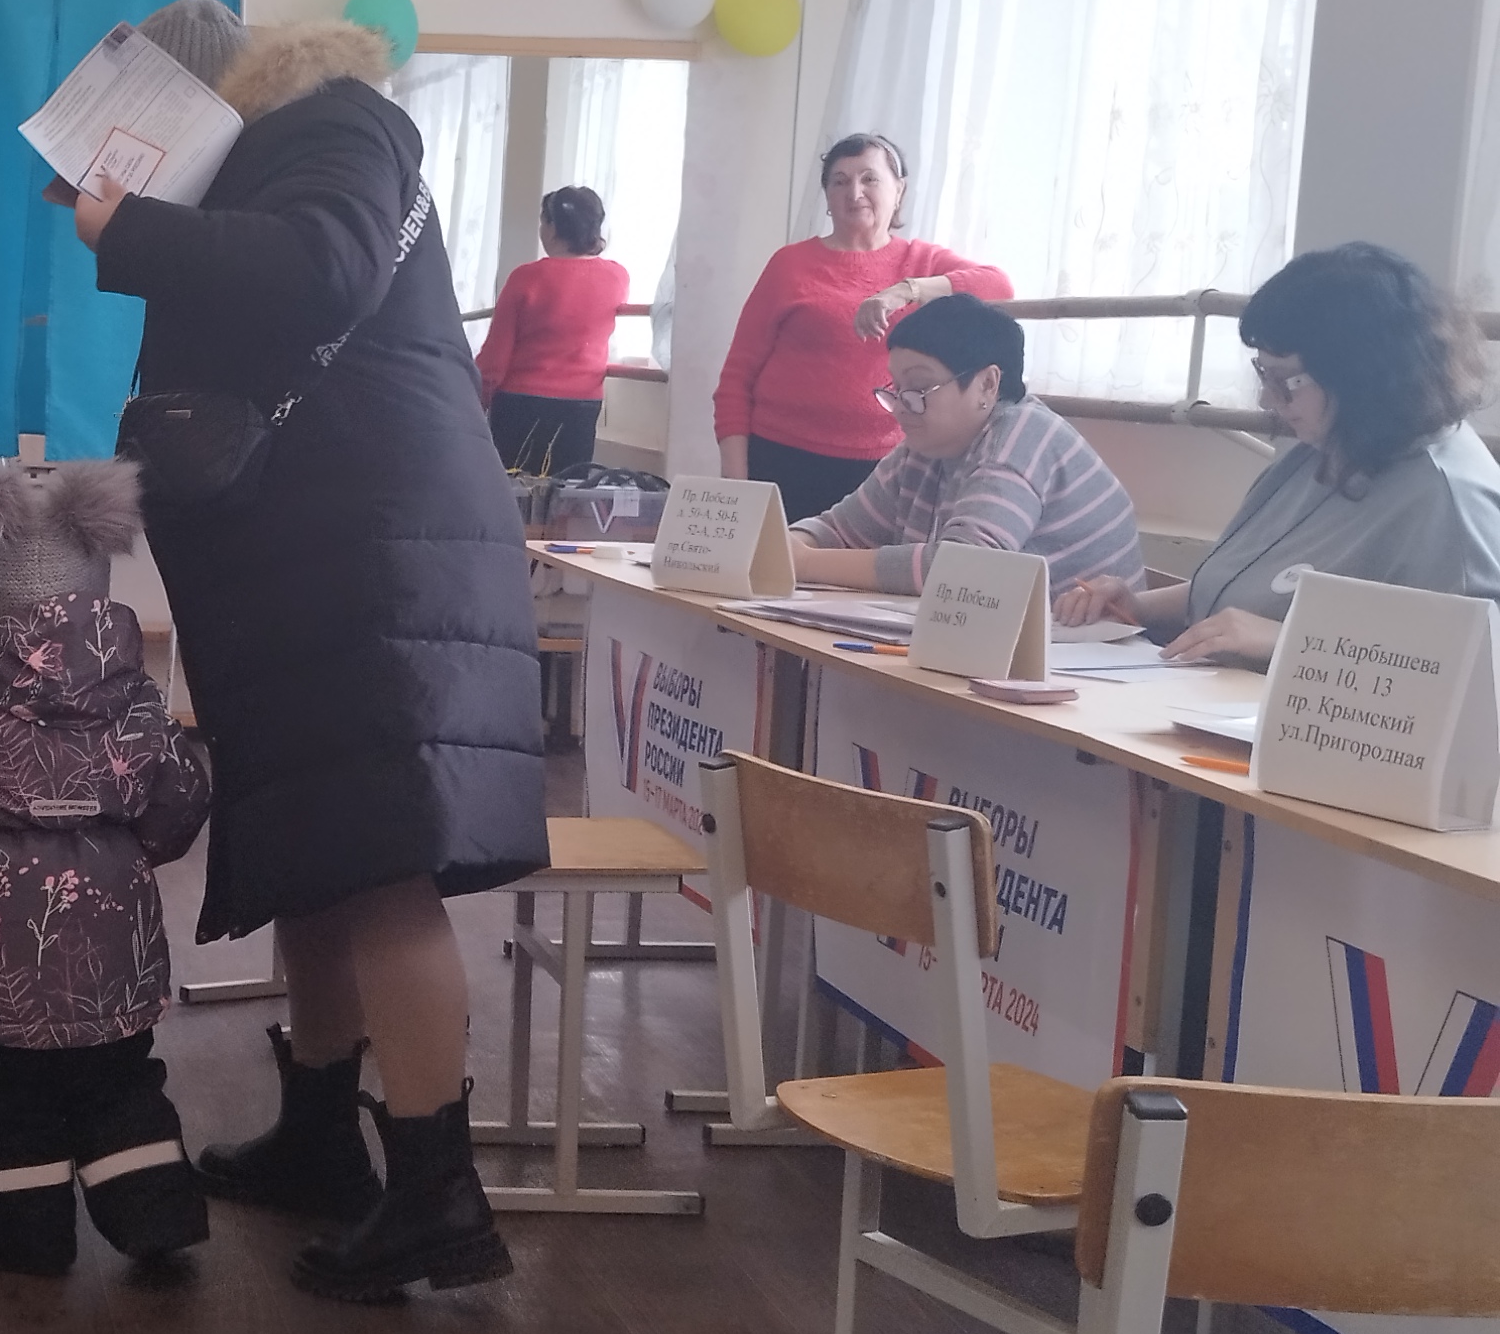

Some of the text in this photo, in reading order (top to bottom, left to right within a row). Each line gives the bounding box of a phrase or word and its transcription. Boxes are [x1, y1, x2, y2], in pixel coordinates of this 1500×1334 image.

[681, 489, 740, 506] Пр. Победы
[928, 610, 967, 627] дом 50
[936, 583, 1000, 610] Пр. Победы
[1300, 635, 1441, 675] ул. Карбышева
[653, 662, 703, 709] ВЫБОРЫ
[1292, 665, 1393, 697] дом 10, 13
[647, 701, 724, 758] ПРЕЗИДЕНТА
[1286, 693, 1415, 735] пр. Крымский
[644, 740, 685, 788] РОССИИ
[1278, 723, 1426, 770] ул.Пригородная
[995, 864, 1068, 935] ДЕНТА
[1004, 988, 1040, 1037] 2024
